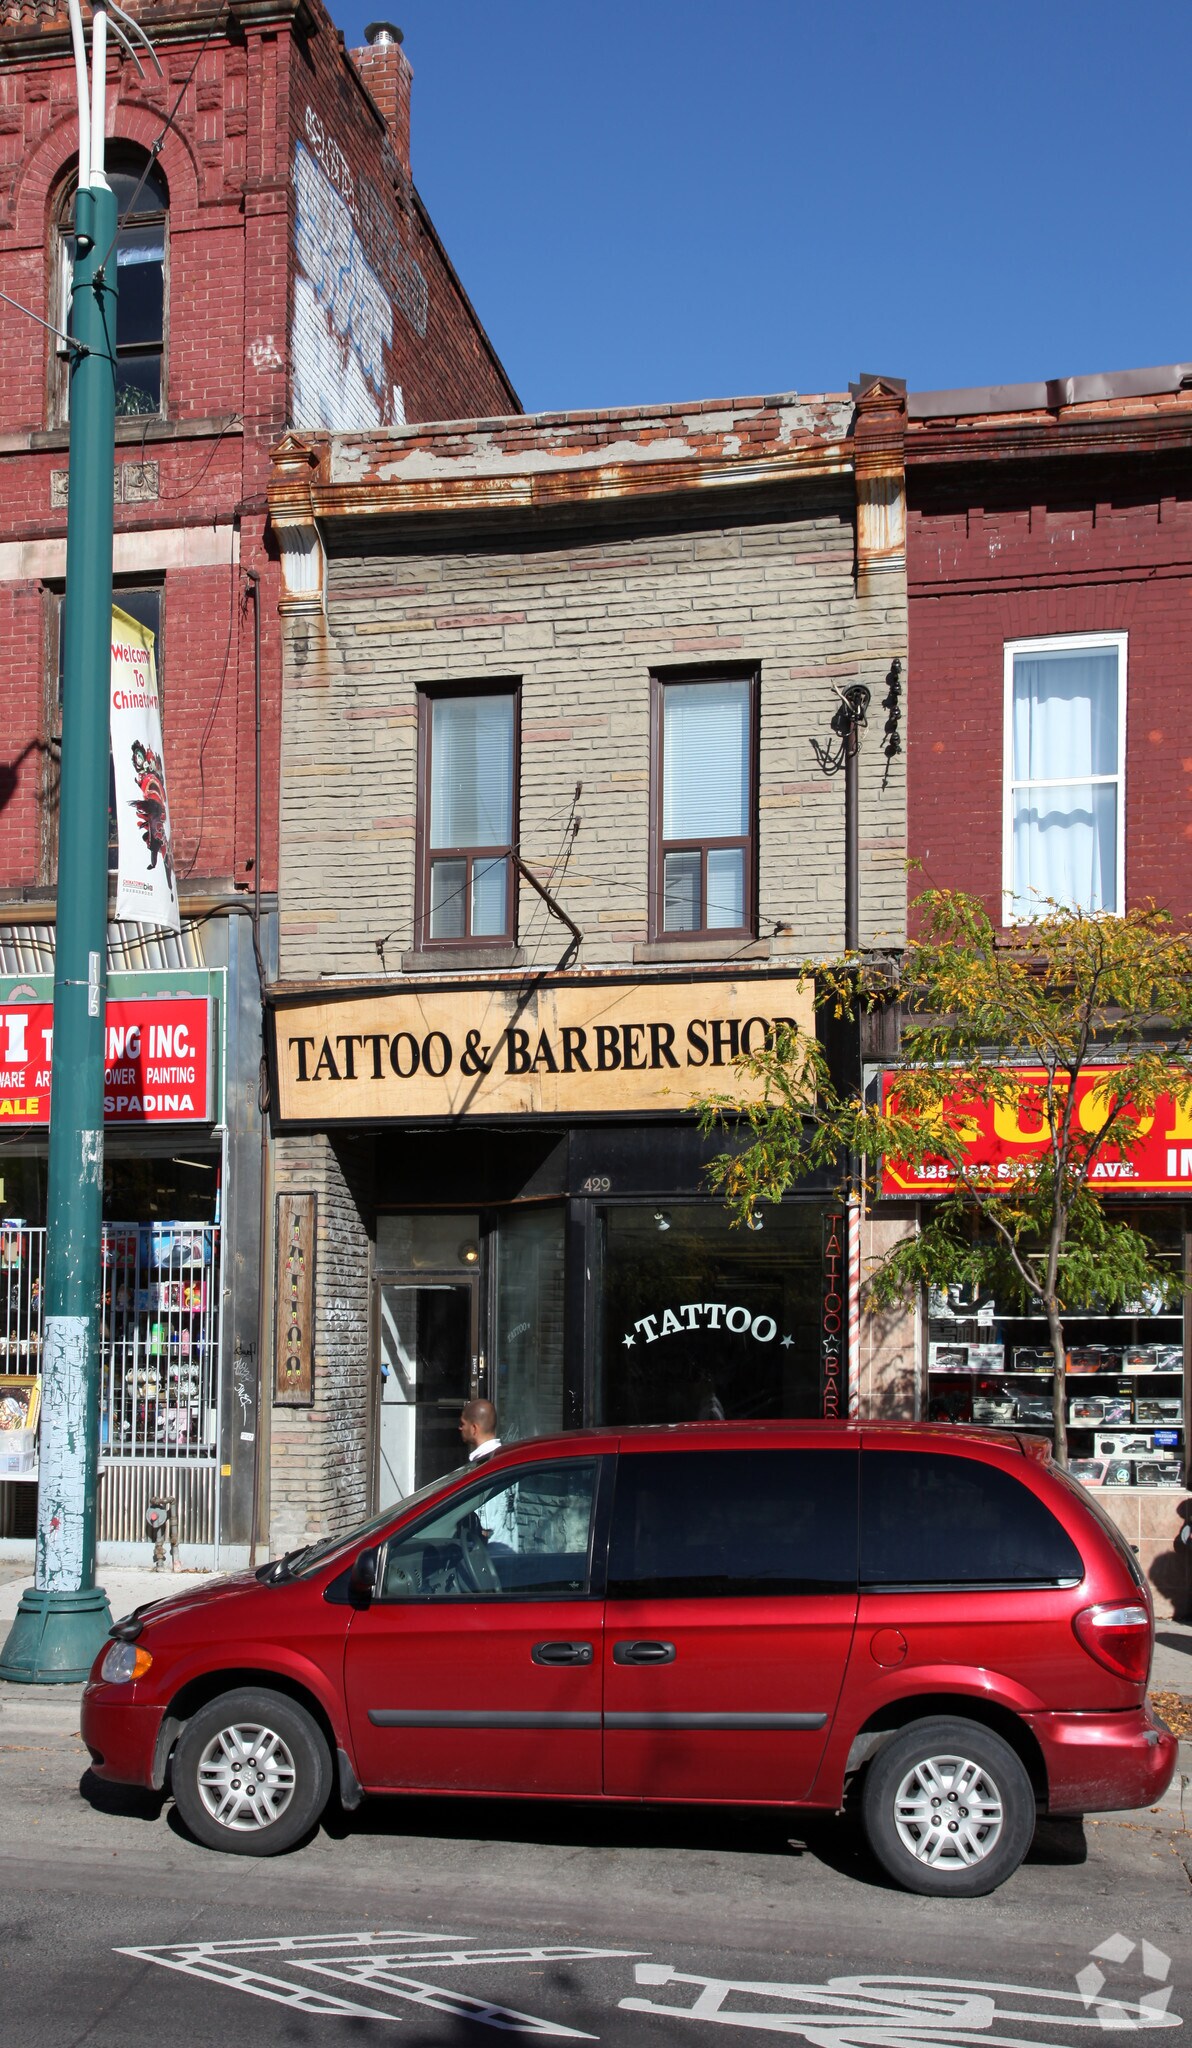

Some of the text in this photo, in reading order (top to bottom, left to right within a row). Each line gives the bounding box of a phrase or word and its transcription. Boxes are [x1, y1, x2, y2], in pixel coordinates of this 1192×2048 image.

[133, 669, 145, 688] To
[149, 1024, 196, 1059] INC.
[288, 1032, 453, 1082] TATTOO
[459, 1030, 492, 1076] &
[505, 1022, 680, 1075] BARBER
[35, 1070, 52, 1087] AR
[104, 1068, 136, 1085] OWER
[146, 1067, 195, 1084] PAINTING
[103, 1094, 194, 1112] SPADINA
[1092, 1162, 1140, 1178] AVE.
[583, 1177, 611, 1192] 429
[634, 1303, 778, 1344] TATTOO
[823, 1214, 842, 1420] TATTOO BAR
